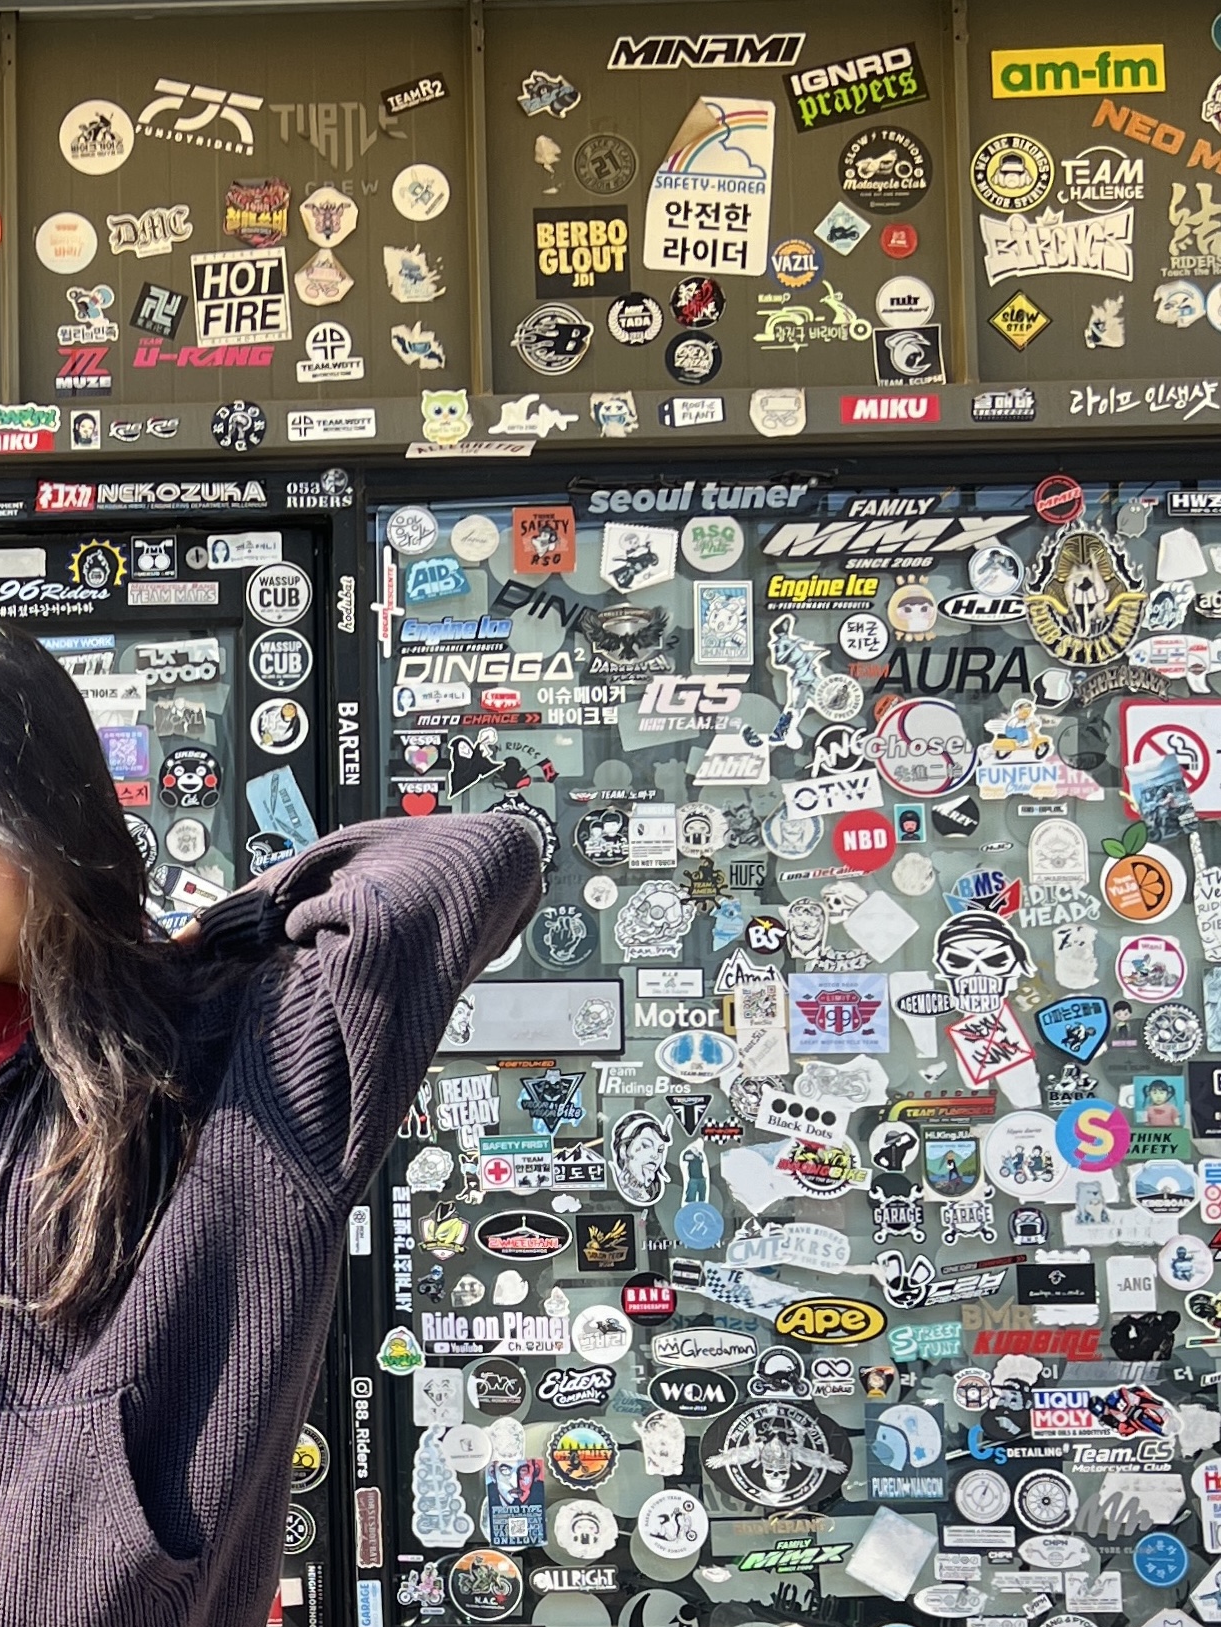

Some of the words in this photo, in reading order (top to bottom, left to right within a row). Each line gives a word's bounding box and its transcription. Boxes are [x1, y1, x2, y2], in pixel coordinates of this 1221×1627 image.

[610, 35, 801, 66] MINAMI
[790, 48, 913, 96] IGNRD
[1001, 52, 1157, 93] am-fm
[387, 87, 421, 109] TEAM
[418, 78, 445, 99] R2
[797, 69, 918, 127] prayers
[268, 101, 409, 172] TURTLE
[1092, 98, 1186, 156] NEO
[135, 124, 254, 156] FUNJOYRIDERS
[845, 139, 871, 165] SLOW
[880, 130, 924, 165] TENSION
[1061, 158, 1144, 185] TEAM
[654, 175, 766, 195] SAFETY-KOREA
[1058, 185, 1144, 204] CHALLENGE
[665, 201, 752, 233] 안전한
[537, 219, 628, 250] BERBO
[538, 245, 627, 275] GLOUT
[663, 237, 748, 269] 라이더
[771, 254, 819, 272] VAZIL
[201, 261, 279, 298] HOT
[572, 273, 594, 287] JDI
[201, 300, 282, 336] FIRE
[620, 316, 651, 328] TADA
[1001, 308, 1040, 324] SLOW
[132, 344, 276, 368] U-RANG
[56, 376, 112, 390] MUZE
[853, 398, 929, 420] MIKU
[1069, 388, 1141, 417] 라이프
[1145, 382, 1220, 421] 인생샷
[97, 482, 266, 503] NEKOZUKA
[286, 495, 353, 509] RIDERS
[587, 482, 696, 515] seoul
[701, 478, 808, 511] tuner
[848, 497, 934, 517] FAMILY
[763, 515, 1029, 557] MMX
[41, 584, 110, 600] Riders
[259, 575, 300, 587] WASSUP
[768, 576, 842, 601] Engine
[846, 576, 879, 596] Ice
[259, 588, 300, 608] CUB
[948, 599, 1025, 618] HJC
[401, 619, 476, 644] Engine
[481, 616, 512, 638] Ice
[260, 640, 302, 651] WASSUP
[259, 653, 302, 674] CUB
[887, 647, 1032, 694] AURA
[537, 686, 627, 704] 이슈메이커
[417, 715, 460, 725] MOTO
[462, 713, 519, 724] CHANCE
[548, 707, 619, 724] 바이크팀
[337, 702, 360, 785] BARTEN
[978, 765, 1057, 782] FUNFUN
[843, 828, 888, 851] NBD
[730, 867, 764, 887] HUFS
[959, 871, 1004, 895] BMS
[1021, 903, 1087, 928] HEAD
[750, 927, 786, 950] BS
[959, 978, 998, 994] FOUR
[959, 993, 999, 1013] NERD
[634, 1004, 720, 1028] Motor
[442, 1077, 493, 1101] READY
[608, 1076, 653, 1095] Riding
[655, 1076, 691, 1094] Bros
[439, 1099, 499, 1127] STEADY
[768, 1114, 803, 1132] Black
[805, 1122, 834, 1140] Dots
[482, 1140, 520, 1151] SAFETY
[521, 1139, 549, 1150] FIRST
[554, 1164, 604, 1180] 임도단
[873, 1205, 923, 1224] GARAGE
[942, 1205, 993, 1224] GARAGE
[627, 1288, 671, 1301] BANG
[421, 1313, 469, 1341] Ride
[473, 1321, 498, 1341] on
[503, 1311, 570, 1341] Planet
[788, 1306, 869, 1333] Ape
[450, 1342, 483, 1353] YouTube
[1034, 1390, 1091, 1409] LIQUI
[1035, 1410, 1092, 1428] MOLY
[354, 1398, 371, 1479] 88_Riders
[1007, 1446, 1063, 1460] DETAILING
[1072, 1463, 1134, 1473] Motorcycle
[1136, 1462, 1172, 1472] Club
[776, 1538, 811, 1550] FAMILY
[741, 1543, 852, 1572] MMX
